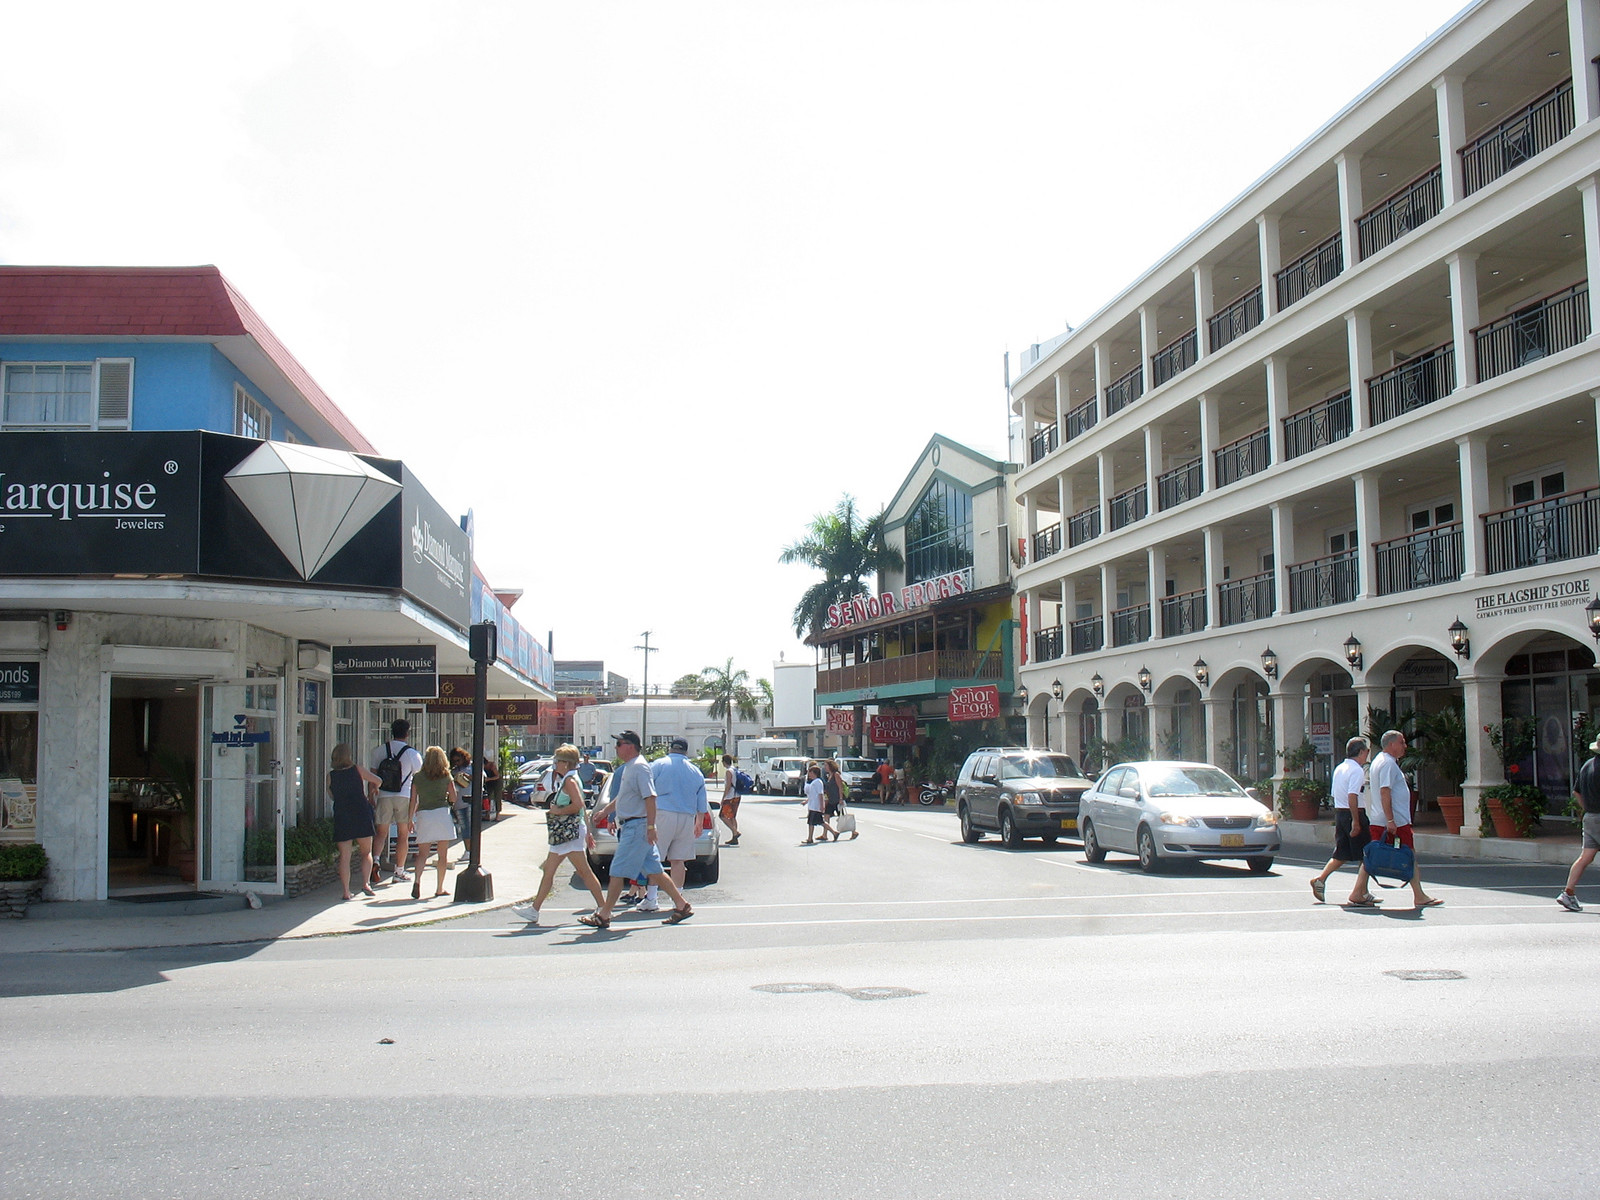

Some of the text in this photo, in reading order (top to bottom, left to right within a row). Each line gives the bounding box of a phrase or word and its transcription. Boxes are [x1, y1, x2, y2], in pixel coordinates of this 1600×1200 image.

[115, 518, 165, 530] Jewelers
[828, 574, 965, 628] SEÑOR FROG'S
[1475, 579, 1590, 609] THE FLAGSHIP STORE
[1503, 606, 1527, 615] PREMIER
[1528, 603, 1543, 612] DUTY
[1544, 601, 1558, 609] FREE
[1560, 596, 1591, 607] SHOPPING
[348, 658, 432, 670] Diamond Marquise
[439, 697, 475, 705] FREEPOR
[950, 687, 994, 704] Señor
